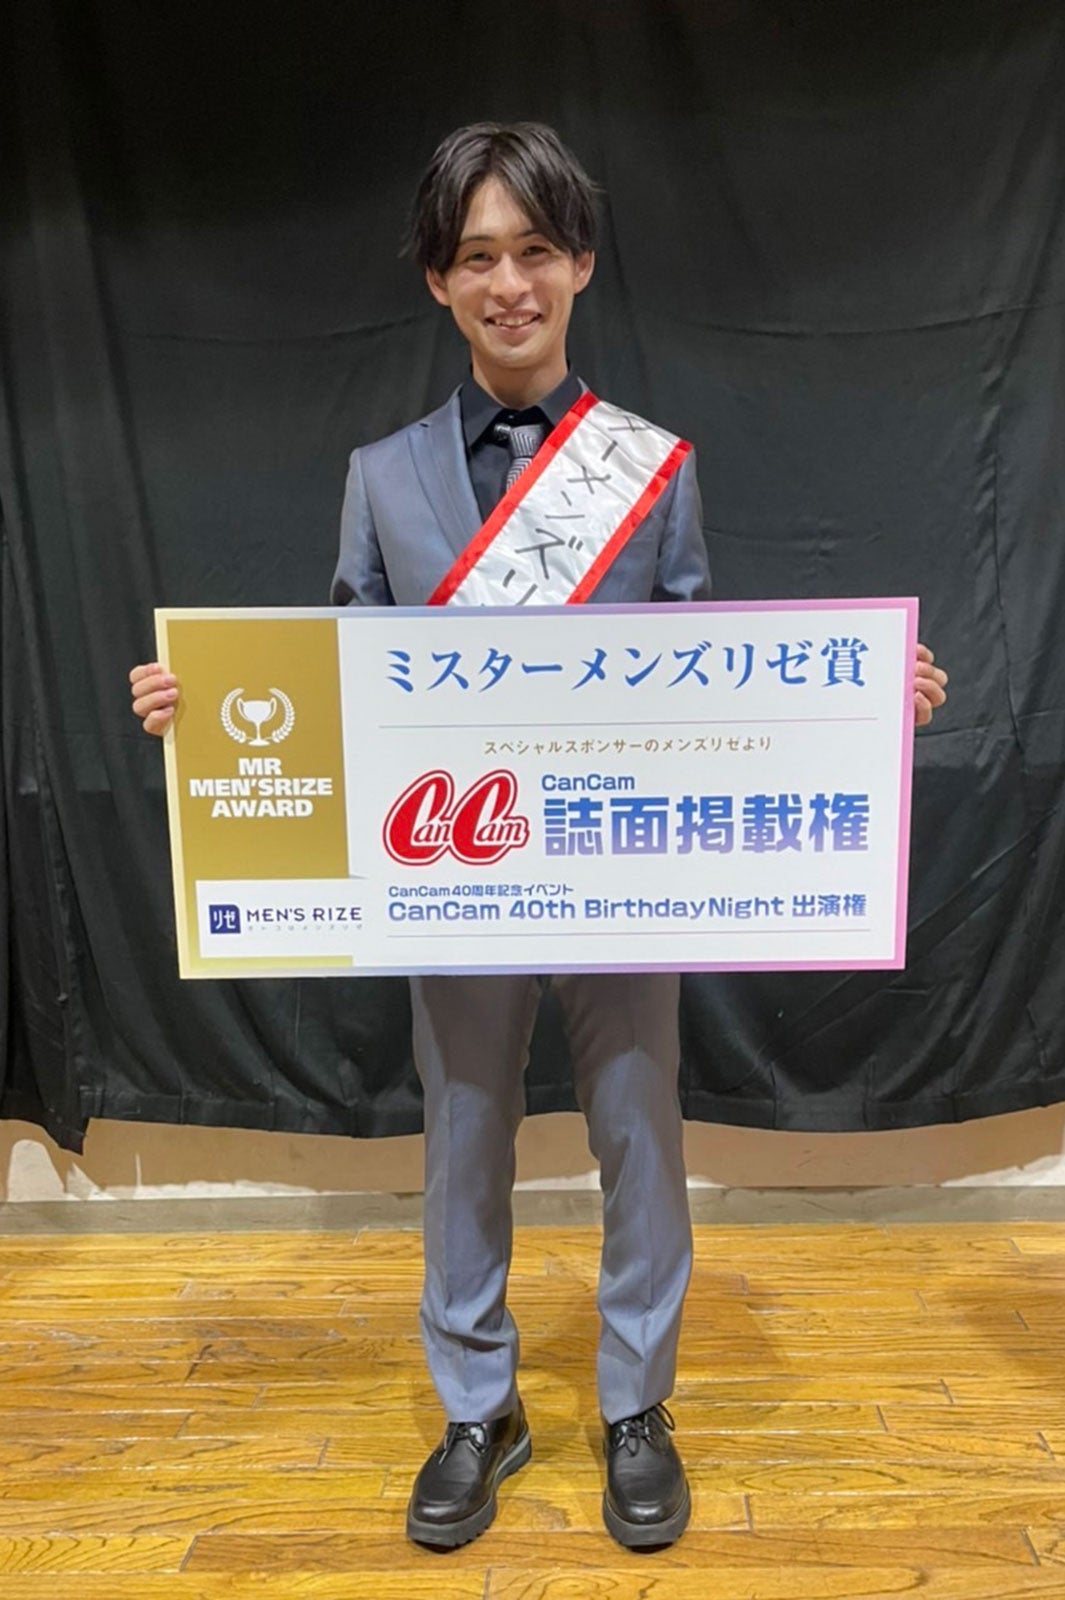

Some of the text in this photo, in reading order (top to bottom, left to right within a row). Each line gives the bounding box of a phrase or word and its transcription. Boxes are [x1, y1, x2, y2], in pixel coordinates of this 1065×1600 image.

[386, 637, 869, 693] ミスターメンズリゼ賞
[484, 735, 772, 755] スペシャルスポンサーのメンズリゼより
[238, 757, 282, 776] MR
[189, 777, 333, 797] MEN'SRIZE
[541, 773, 635, 791] CanCam
[210, 799, 313, 818] AWARD
[384, 770, 530, 866] CanCam
[543, 793, 869, 856] 誌面掲載権
[246, 906, 362, 922] MEN'S RIZE
[388, 901, 500, 921] CanCam
[509, 899, 576, 919] 40th
[792, 894, 867, 917] 出演権
